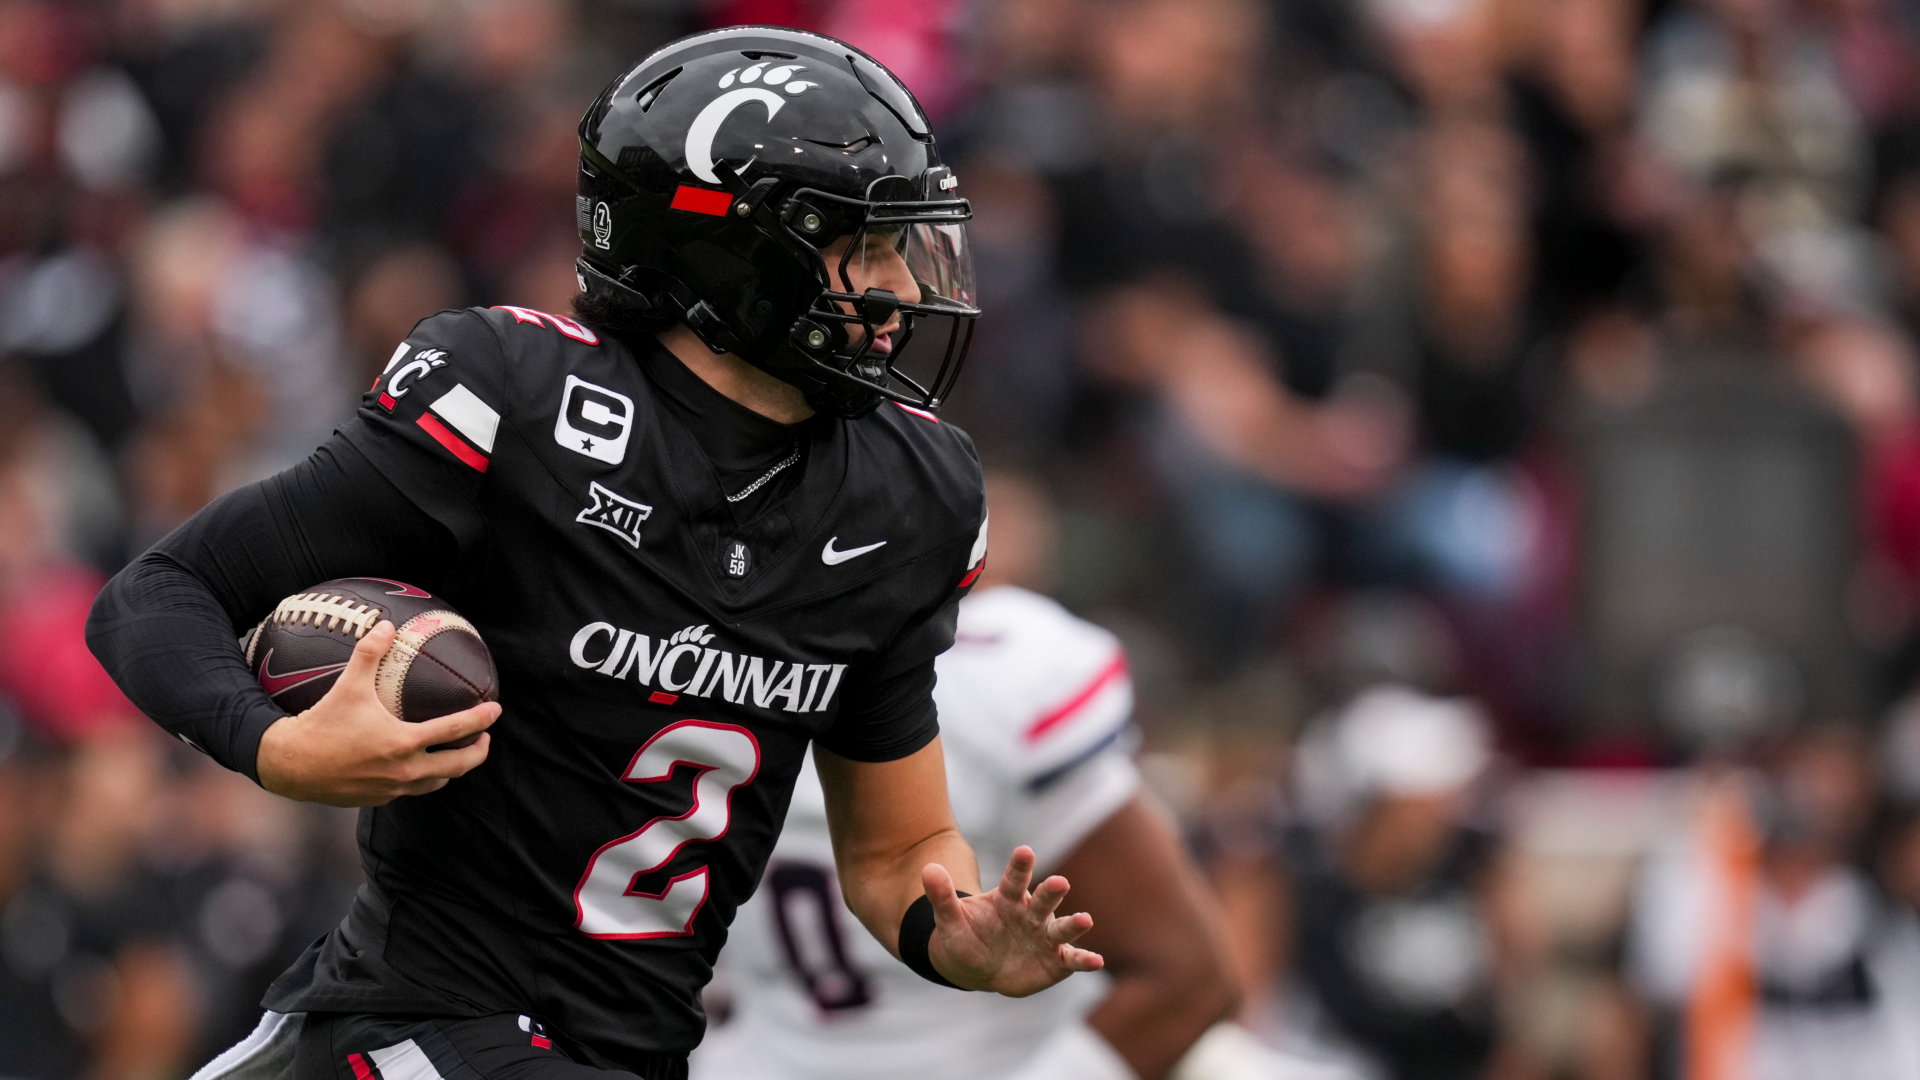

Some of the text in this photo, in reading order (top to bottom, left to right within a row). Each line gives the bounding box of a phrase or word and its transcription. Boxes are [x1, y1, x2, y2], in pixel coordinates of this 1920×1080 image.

[598, 208, 605, 226] 7
[387, 360, 432, 397] C
[565, 384, 627, 441] C
[579, 484, 651, 546] XII
[729, 559, 745, 575] 58
[731, 544, 745, 560] JK
[569, 621, 848, 713] CINCINNATI
[573, 719, 761, 940] 2
